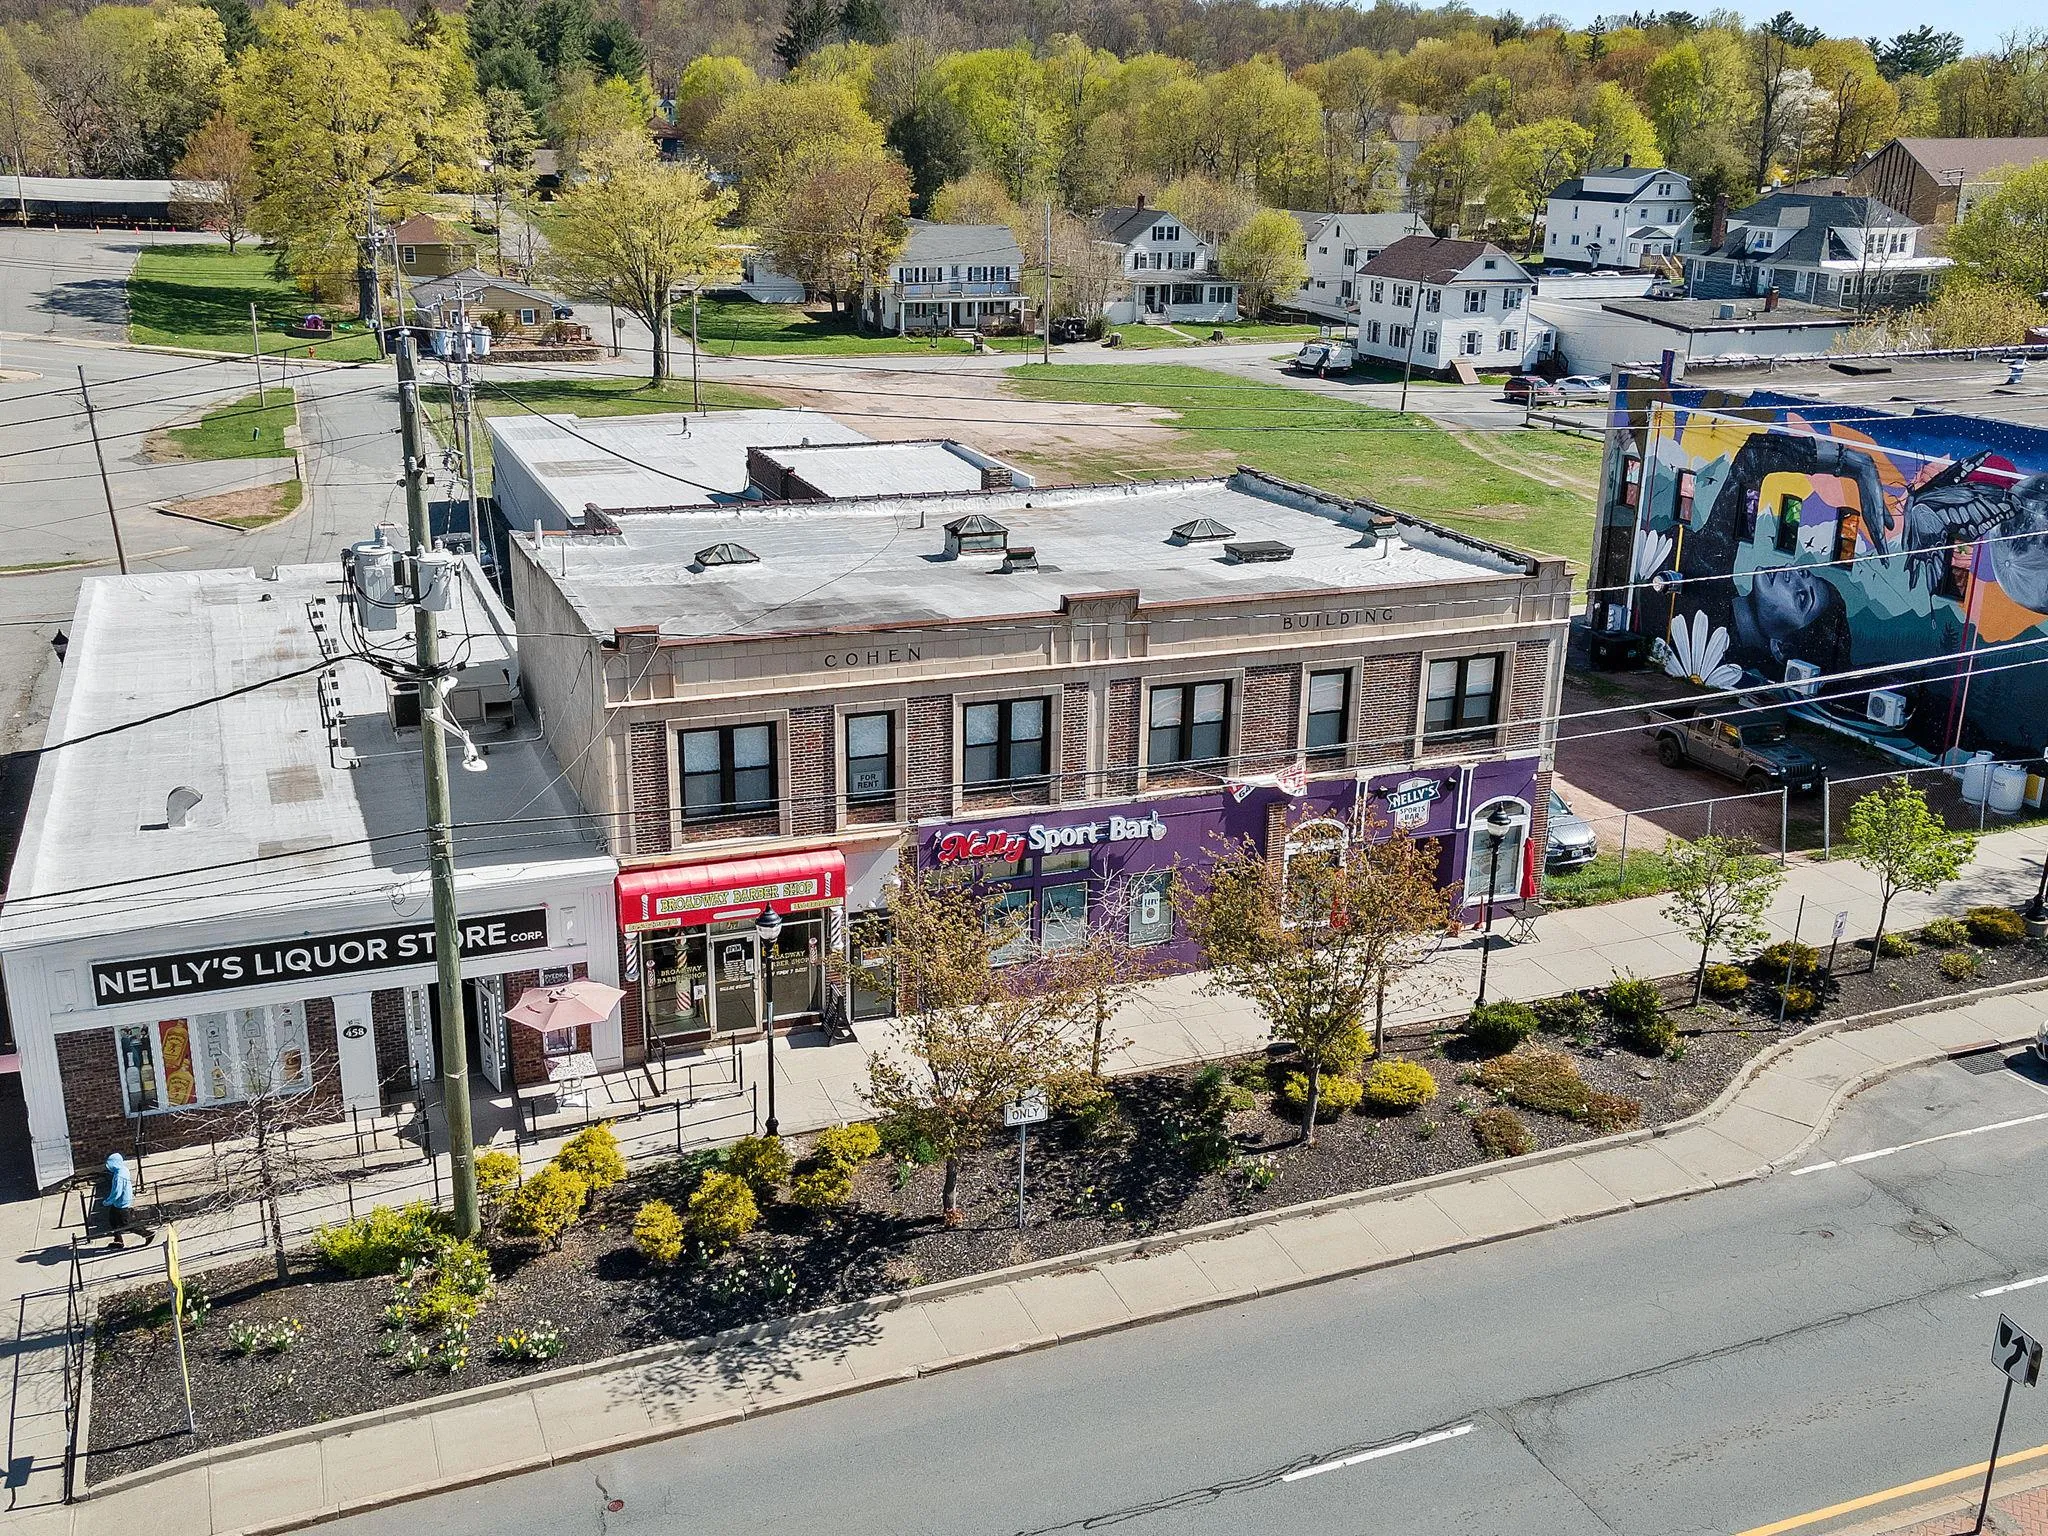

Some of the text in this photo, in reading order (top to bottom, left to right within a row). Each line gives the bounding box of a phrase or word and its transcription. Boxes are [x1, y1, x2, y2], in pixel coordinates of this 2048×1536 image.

[824, 608, 1394, 668] COHEN BUILDING
[860, 773, 876, 782] FOR
[857, 780, 879, 790] RENT
[1391, 785, 1435, 808] NELLY'S
[1400, 806, 1426, 815] SPORTS
[1404, 812, 1420, 820] BAR
[937, 815, 1156, 864] Nelly Sport Bar
[660, 890, 730, 913] BROADWAY
[732, 884, 780, 904] BARBER
[782, 880, 814, 897] SHOP
[98, 922, 544, 997] NELLY'S LIQUOR STRE CORP.
[345, 1027, 365, 1037] 458
[1012, 1107, 1040, 1120] ONLY
